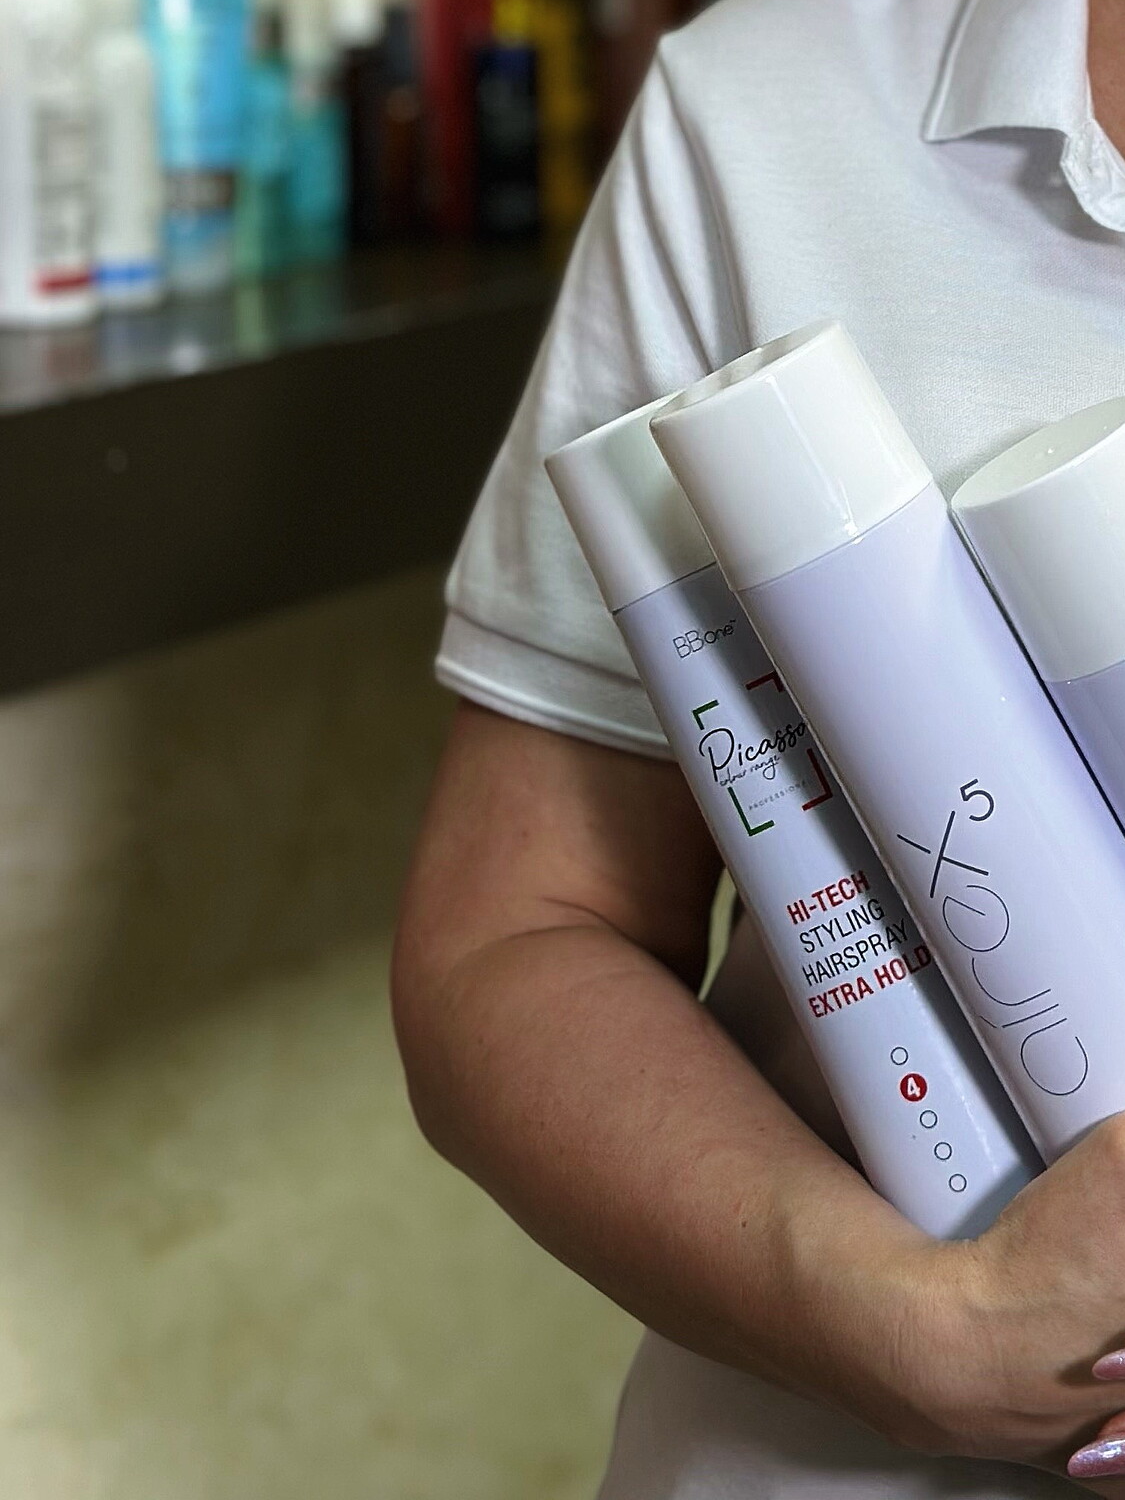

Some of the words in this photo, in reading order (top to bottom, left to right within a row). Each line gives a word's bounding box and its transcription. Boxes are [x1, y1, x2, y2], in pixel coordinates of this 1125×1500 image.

[698, 721, 807, 782] Picasso
[786, 870, 871, 926] HI-TECH
[799, 898, 886, 954] STYLING
[801, 918, 909, 987] HAIRSPRAY
[807, 976, 875, 1019] EXTRA
[875, 944, 932, 991] HOLD
